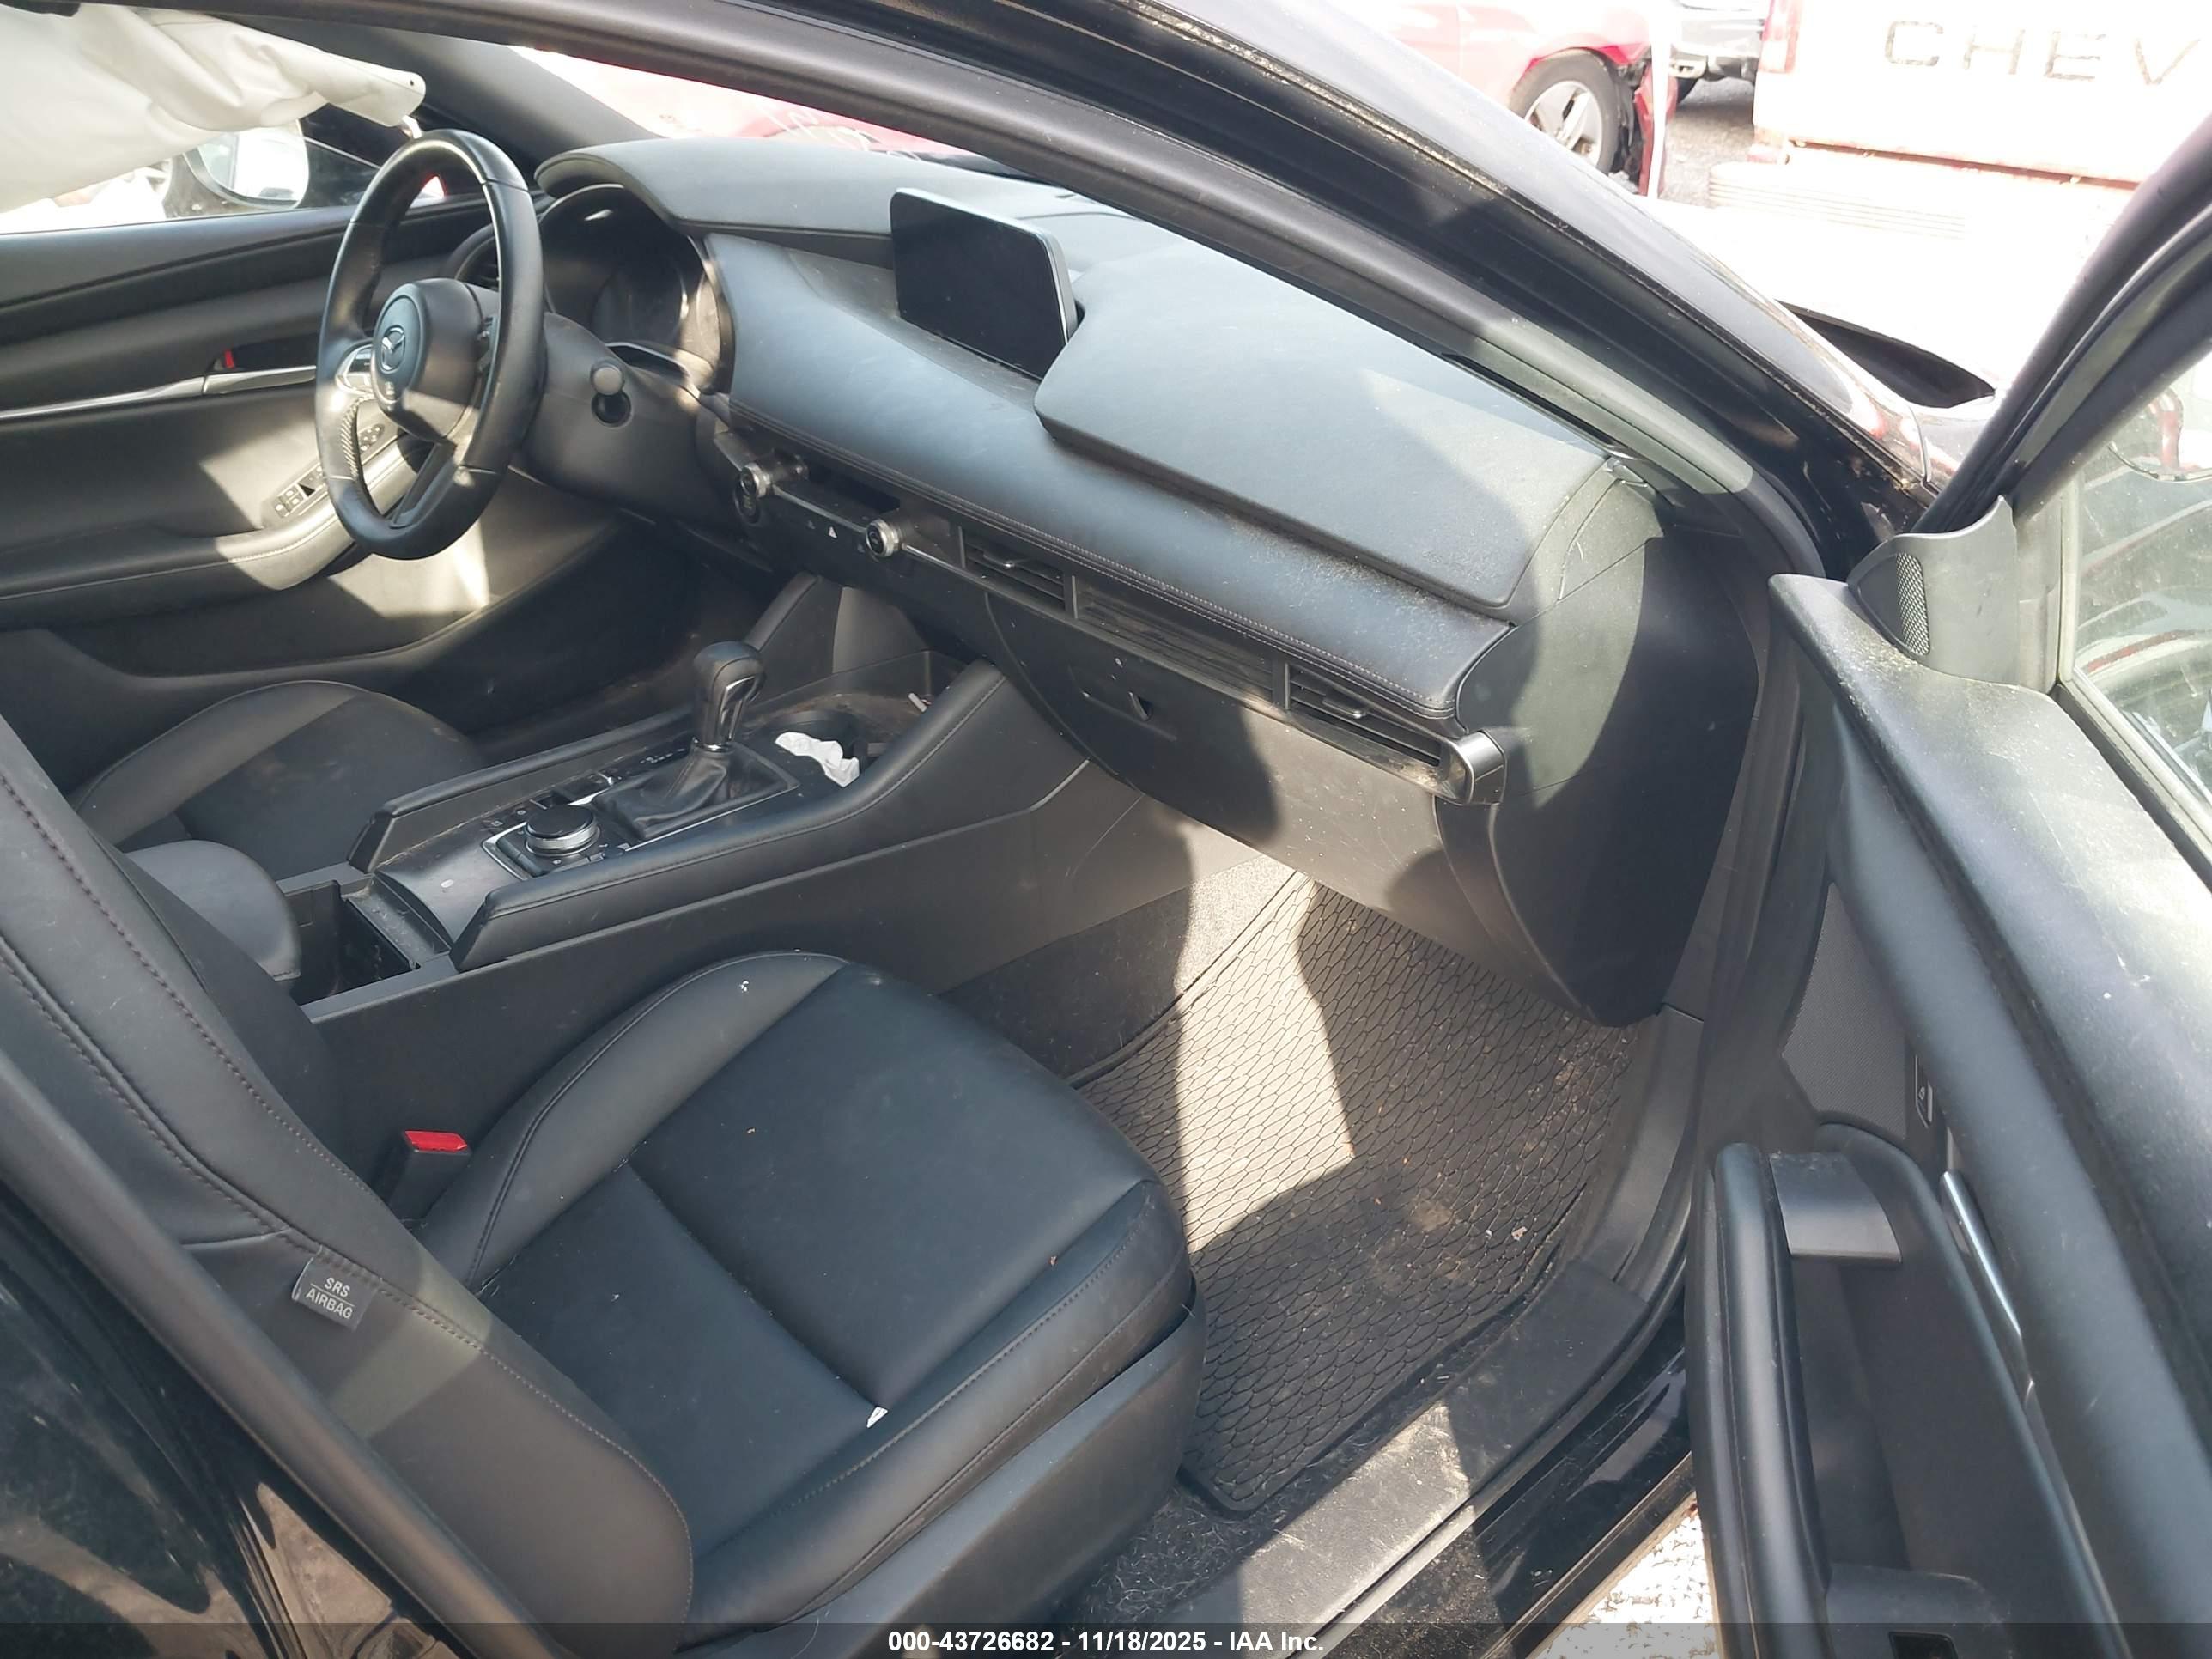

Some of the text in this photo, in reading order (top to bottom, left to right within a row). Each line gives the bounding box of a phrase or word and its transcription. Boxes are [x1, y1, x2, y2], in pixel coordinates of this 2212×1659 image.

[1884, 19, 2202, 86] CHEV
[306, 1287, 354, 1320] AIRBAG
[325, 1277, 351, 1297] SRS
